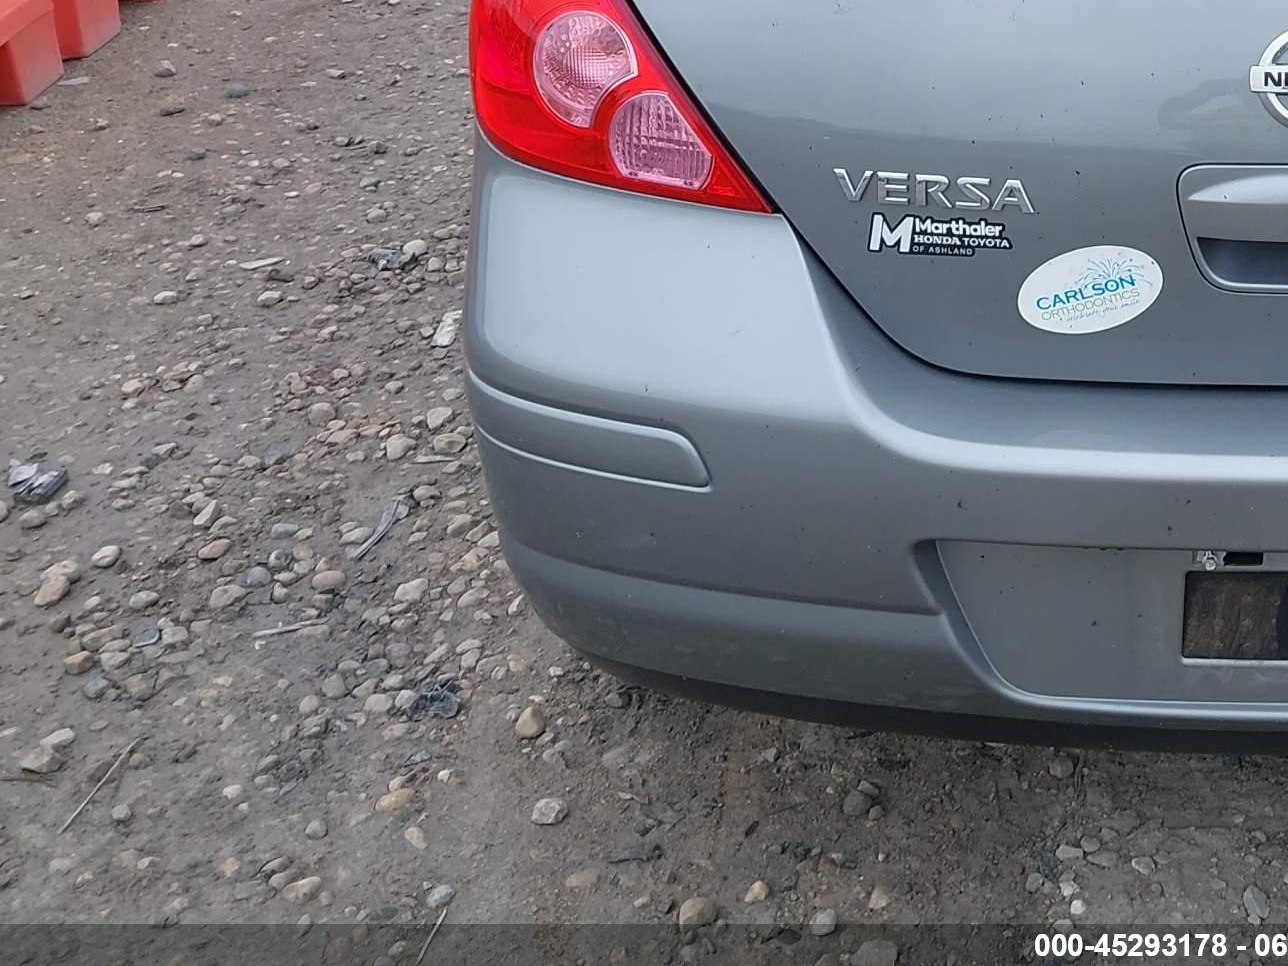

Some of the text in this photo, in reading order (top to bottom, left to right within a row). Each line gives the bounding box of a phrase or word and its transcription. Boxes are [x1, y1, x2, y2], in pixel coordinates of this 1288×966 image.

[832, 167, 1036, 213] VERSA
[869, 214, 914, 253] M
[913, 234, 1010, 248] HONDA TOYOTA
[914, 217, 1003, 236] Marthaler
[912, 245, 974, 256] OF ASHLAND
[1036, 273, 1137, 311] CARLSON
[1040, 288, 1141, 321] ORTHODONTICS
